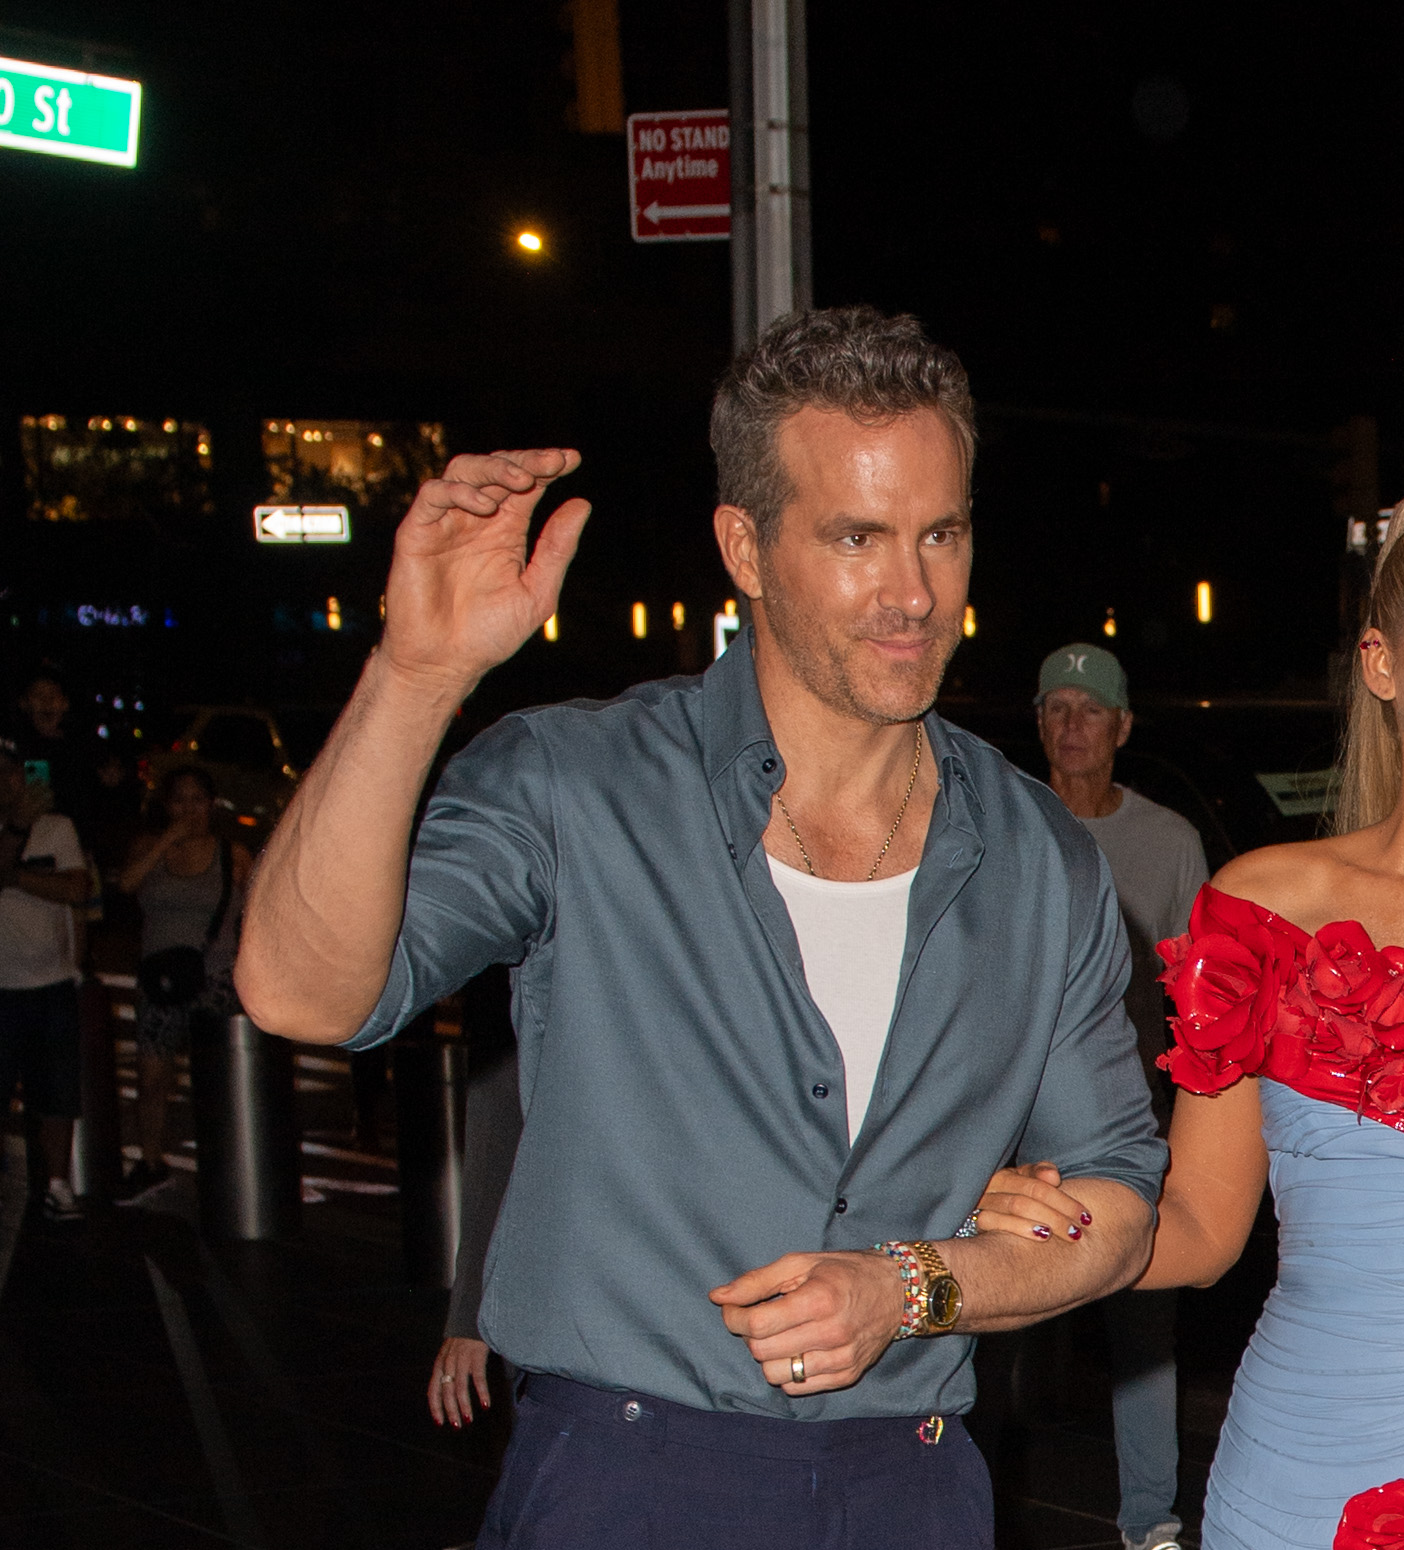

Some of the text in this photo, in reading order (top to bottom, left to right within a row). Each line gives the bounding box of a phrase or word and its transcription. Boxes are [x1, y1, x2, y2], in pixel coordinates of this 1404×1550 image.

[32, 84, 73, 137] St
[639, 127, 667, 152] NO
[641, 154, 719, 184] Anytime
